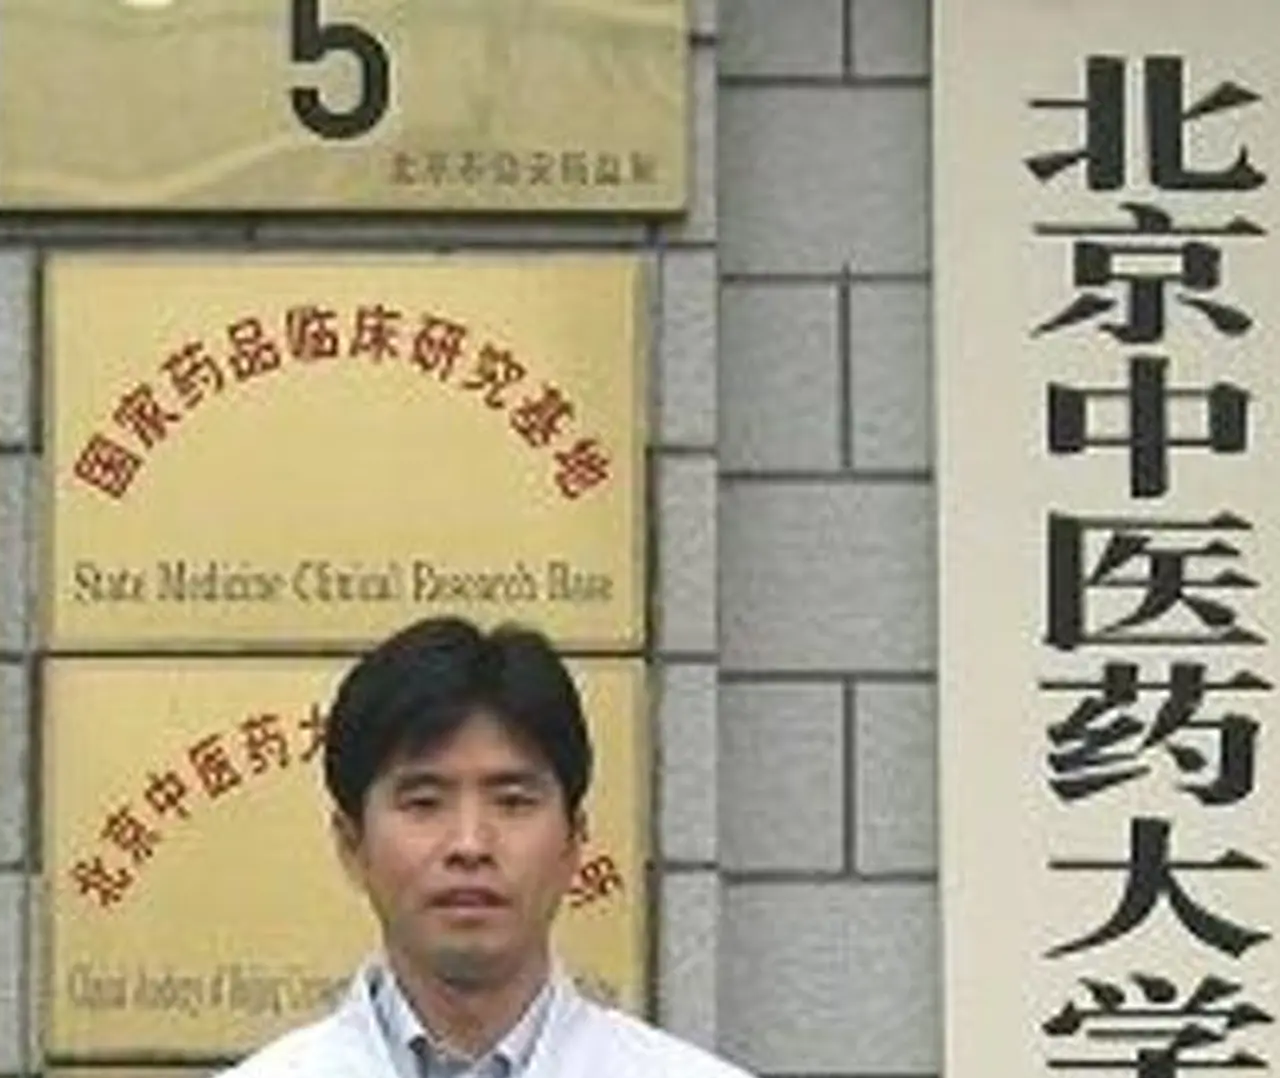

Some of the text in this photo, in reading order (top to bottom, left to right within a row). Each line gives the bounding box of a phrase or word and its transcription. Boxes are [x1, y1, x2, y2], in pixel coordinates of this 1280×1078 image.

[290, 0, 391, 140] 5
[74, 304, 612, 500] 国家药品临床研究基地
[74, 560, 145, 603] State
[157, 560, 287, 603] Medicine
